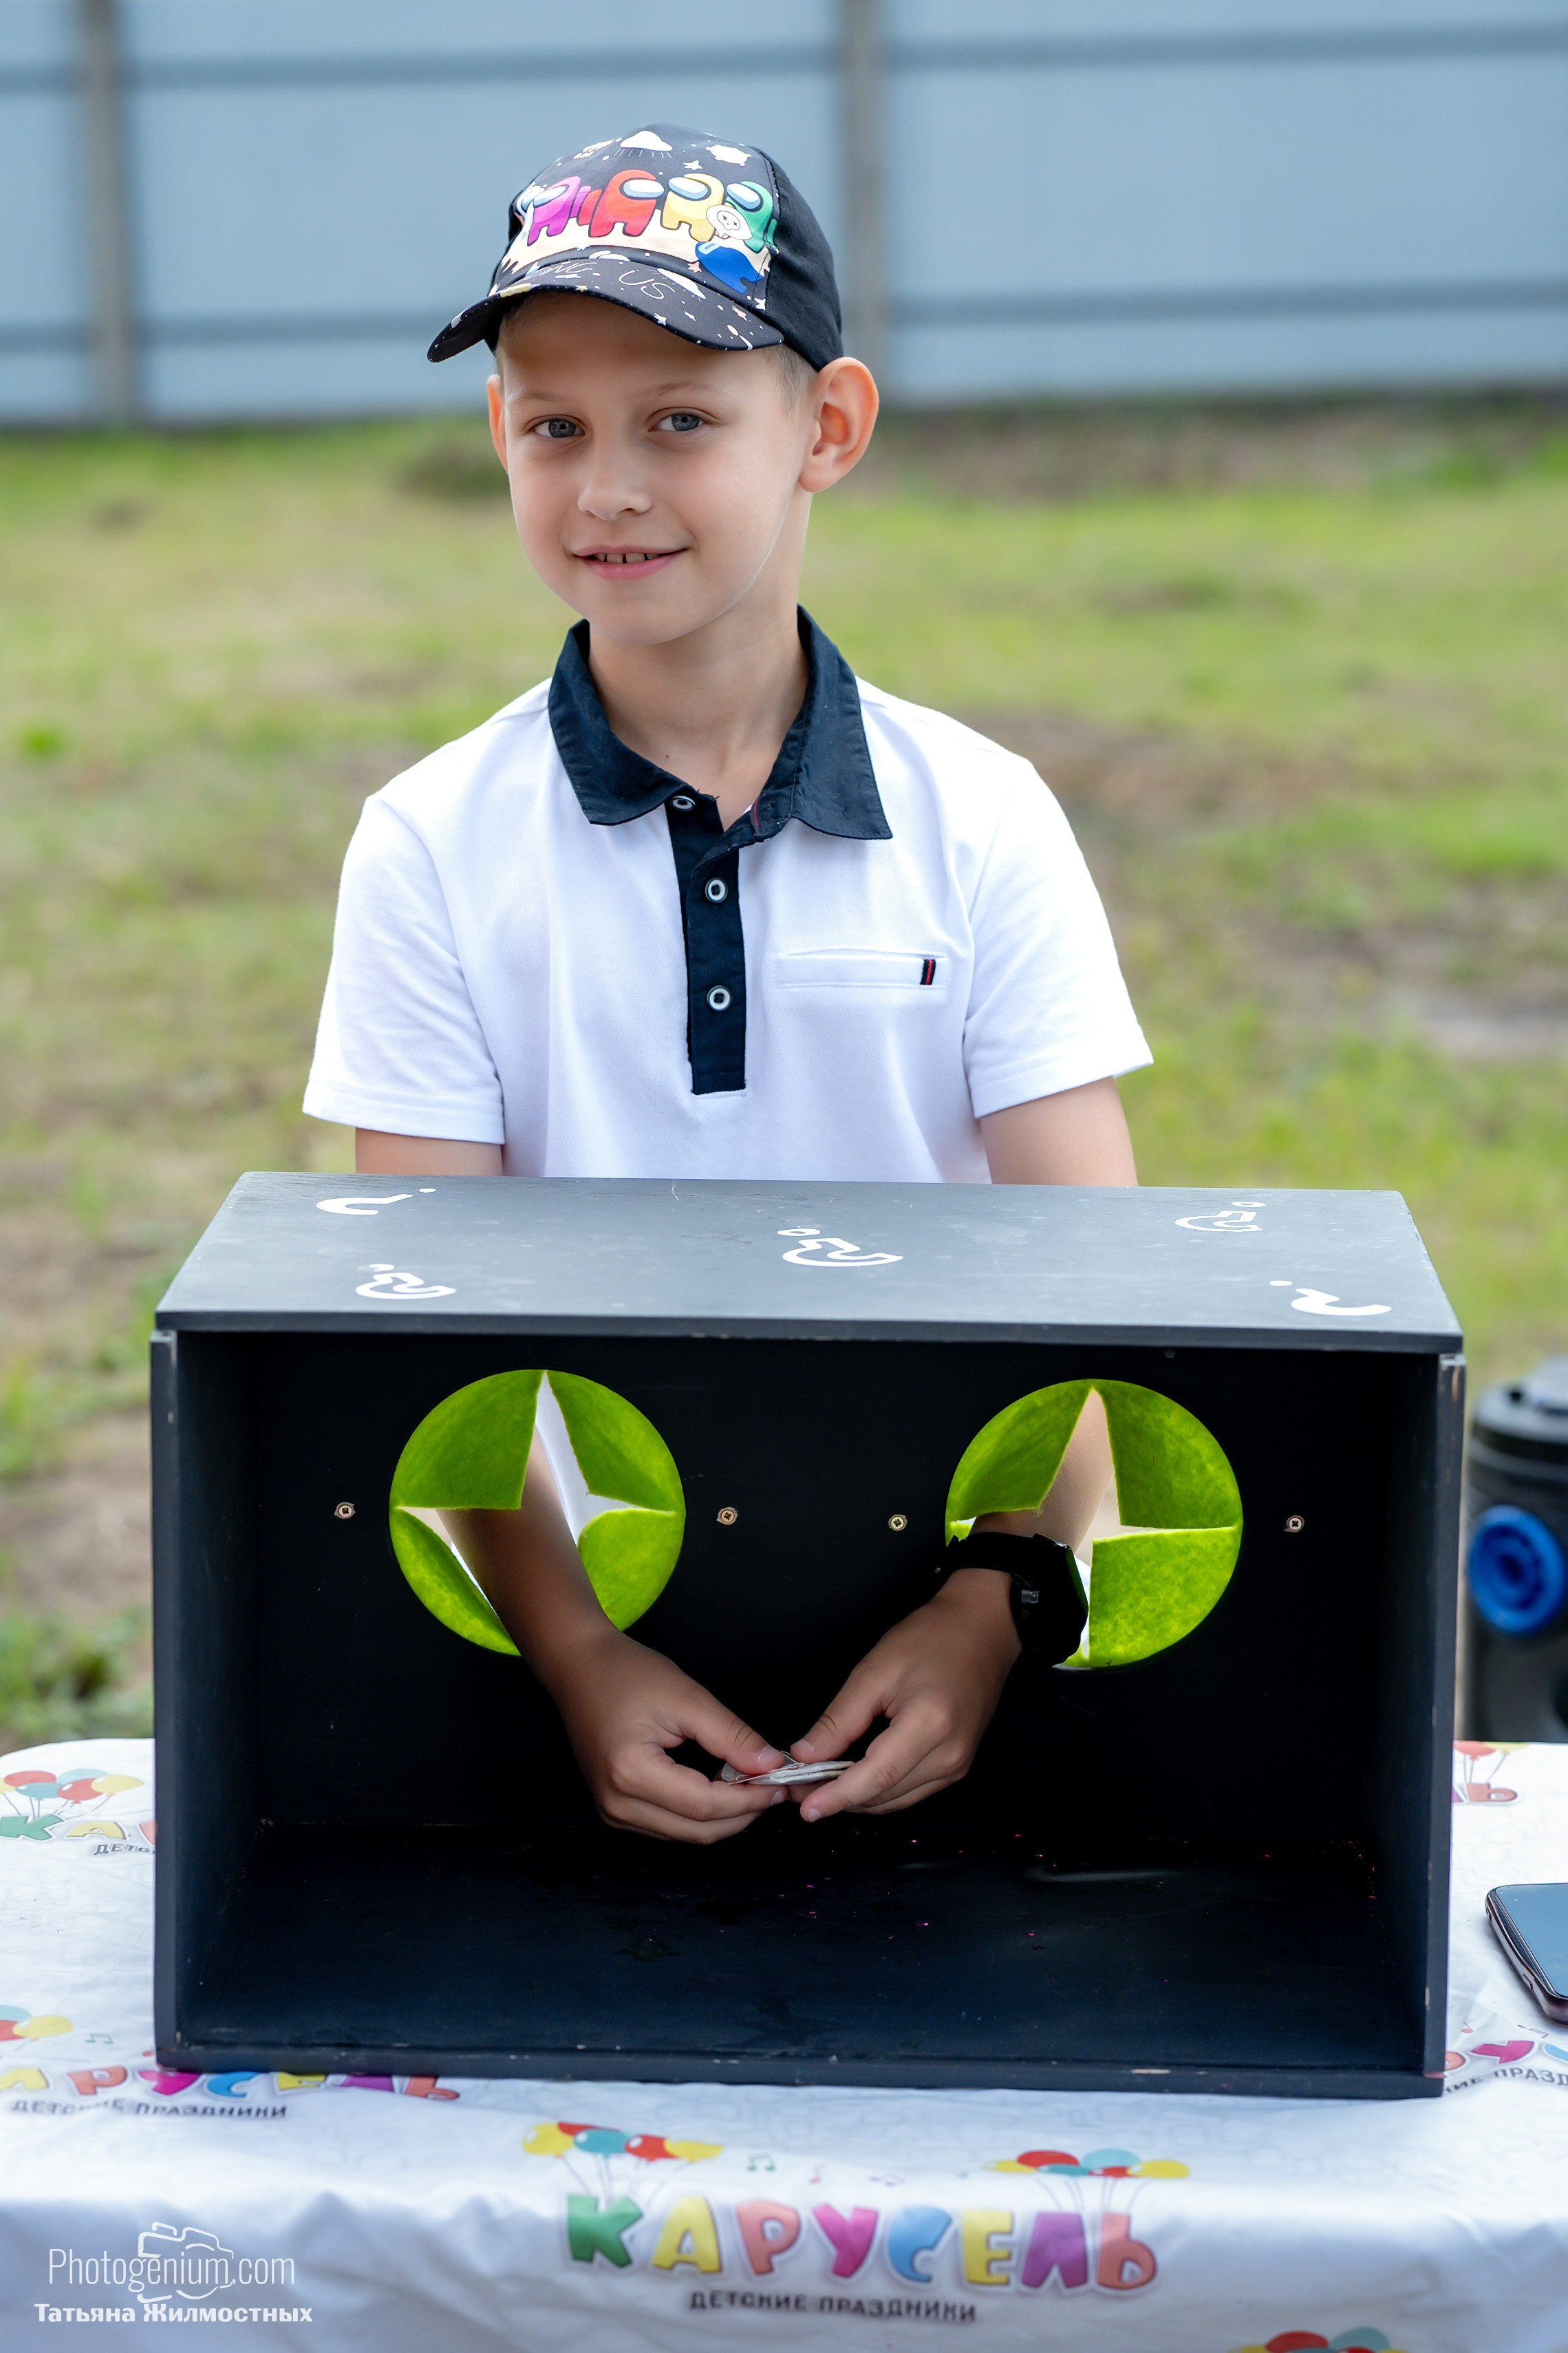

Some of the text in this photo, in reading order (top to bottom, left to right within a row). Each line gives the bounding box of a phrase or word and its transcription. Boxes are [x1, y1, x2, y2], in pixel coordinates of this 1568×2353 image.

[619, 270, 676, 299] US
[94, 1844, 155, 1855] ДЕТС
[566, 2193, 1158, 2292] КАРУСЕЛЬ
[689, 2290, 976, 2323] ДЕТСКИЕ ПРАЗДНИКИ
